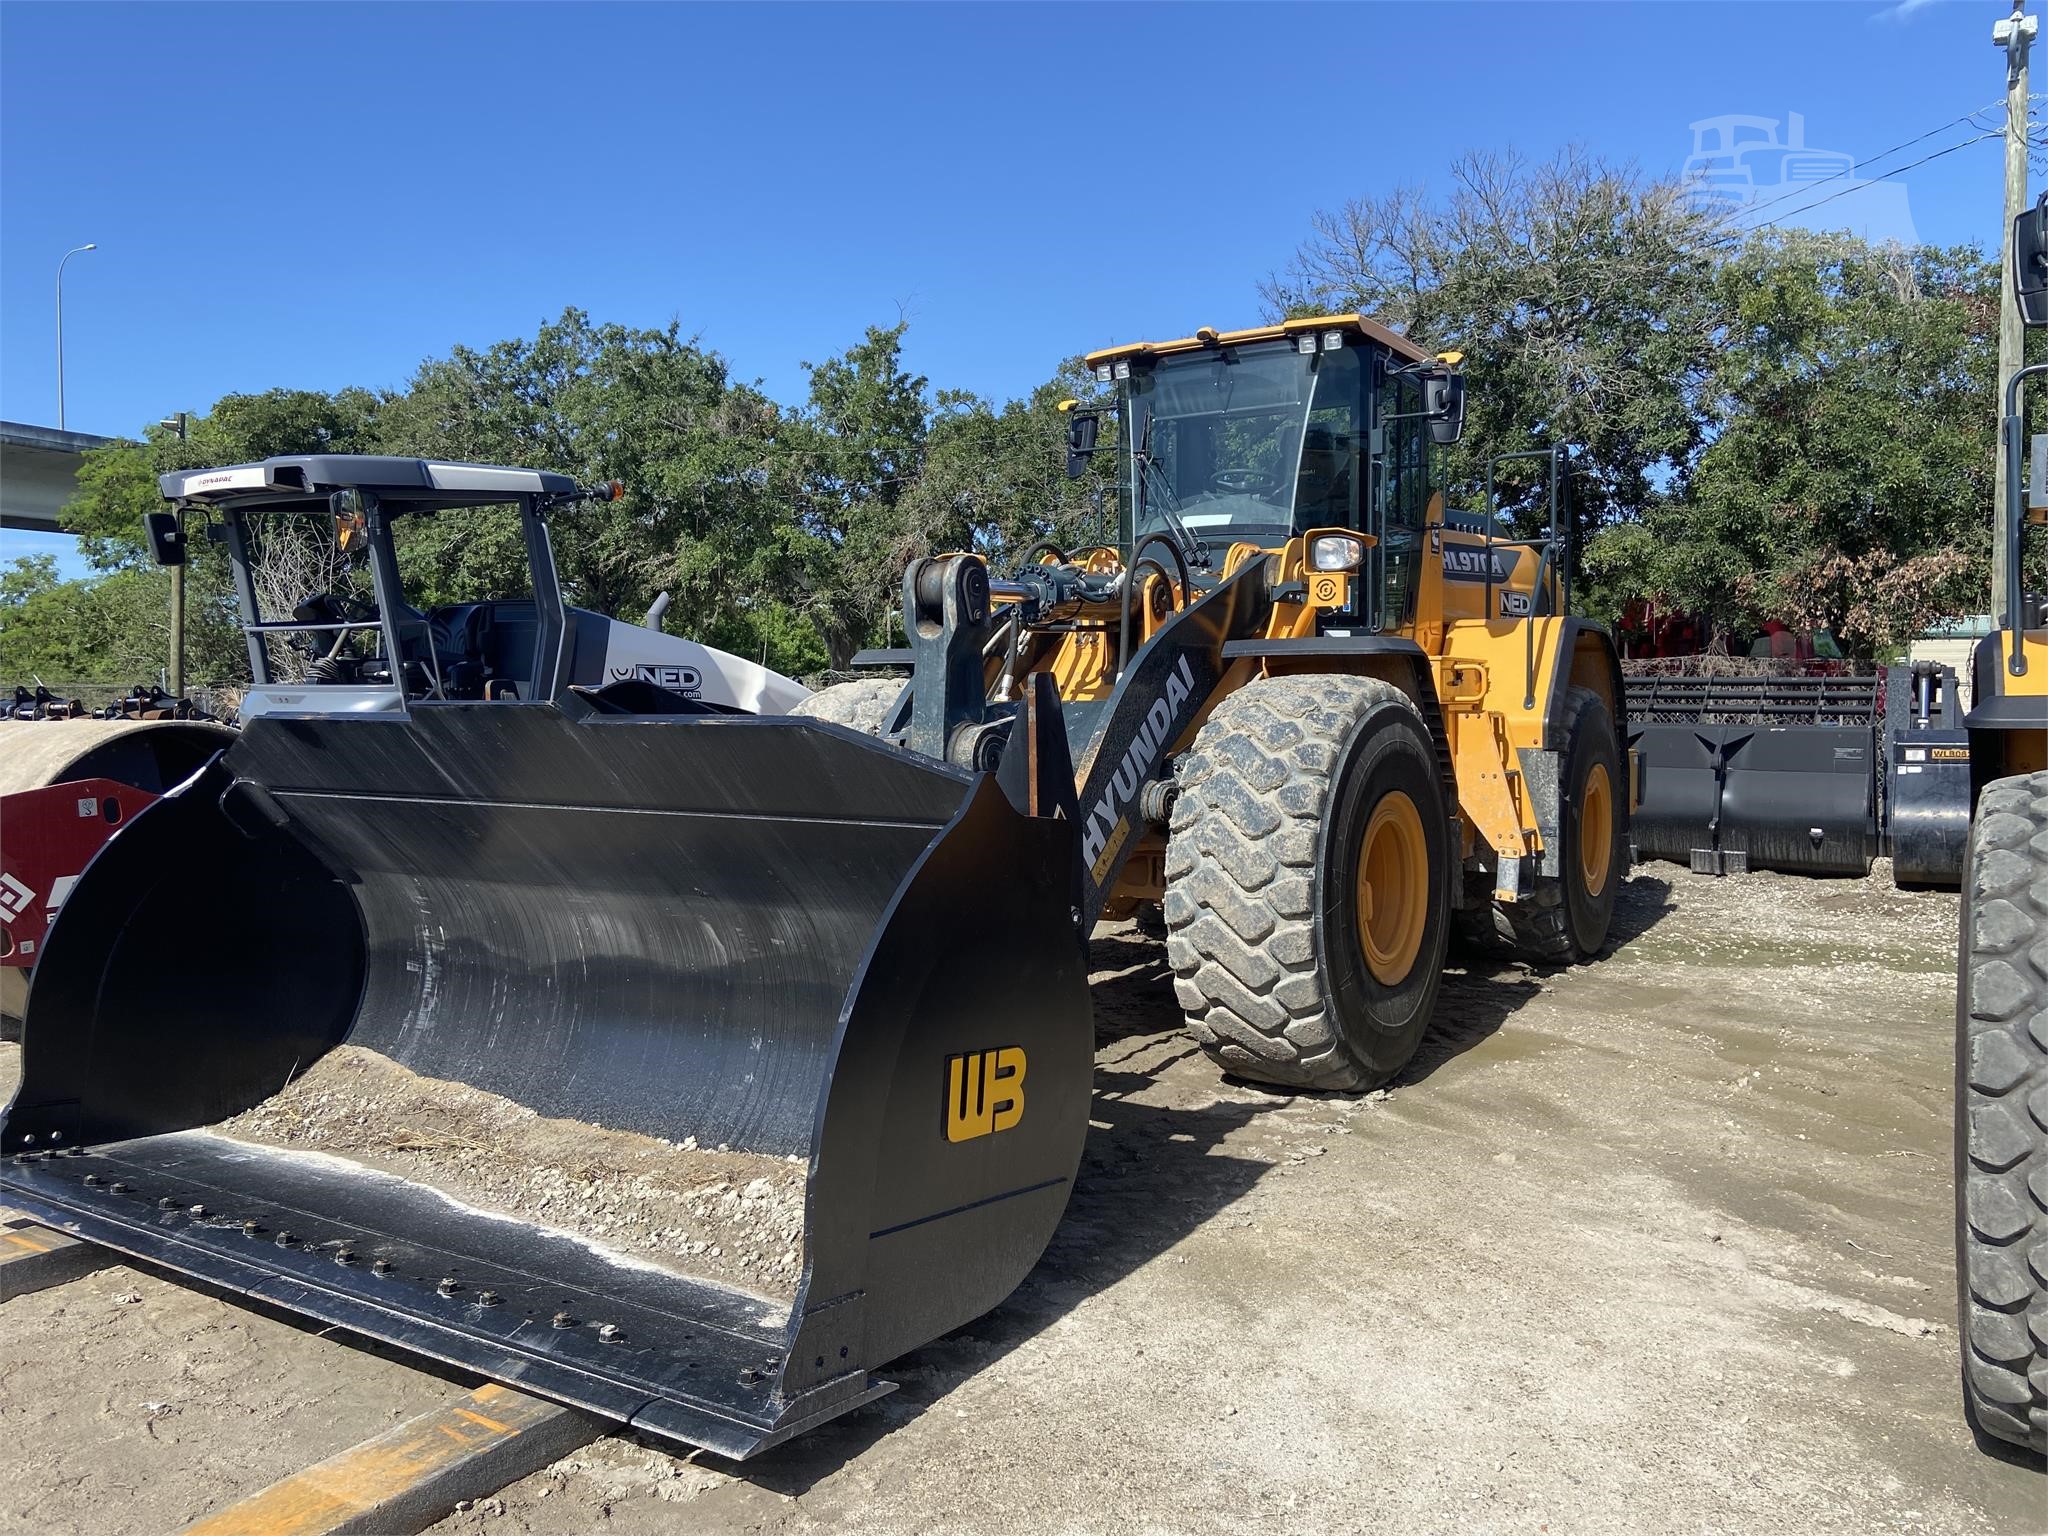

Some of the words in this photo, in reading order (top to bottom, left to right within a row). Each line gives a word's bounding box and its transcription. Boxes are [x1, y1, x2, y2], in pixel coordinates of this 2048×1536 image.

[201, 475, 232, 484] DYNAPAC
[1500, 592, 1531, 614] NED
[638, 667, 700, 687] NED
[1083, 653, 1195, 872] HYUNDAI
[945, 1047, 1027, 1143] WB
